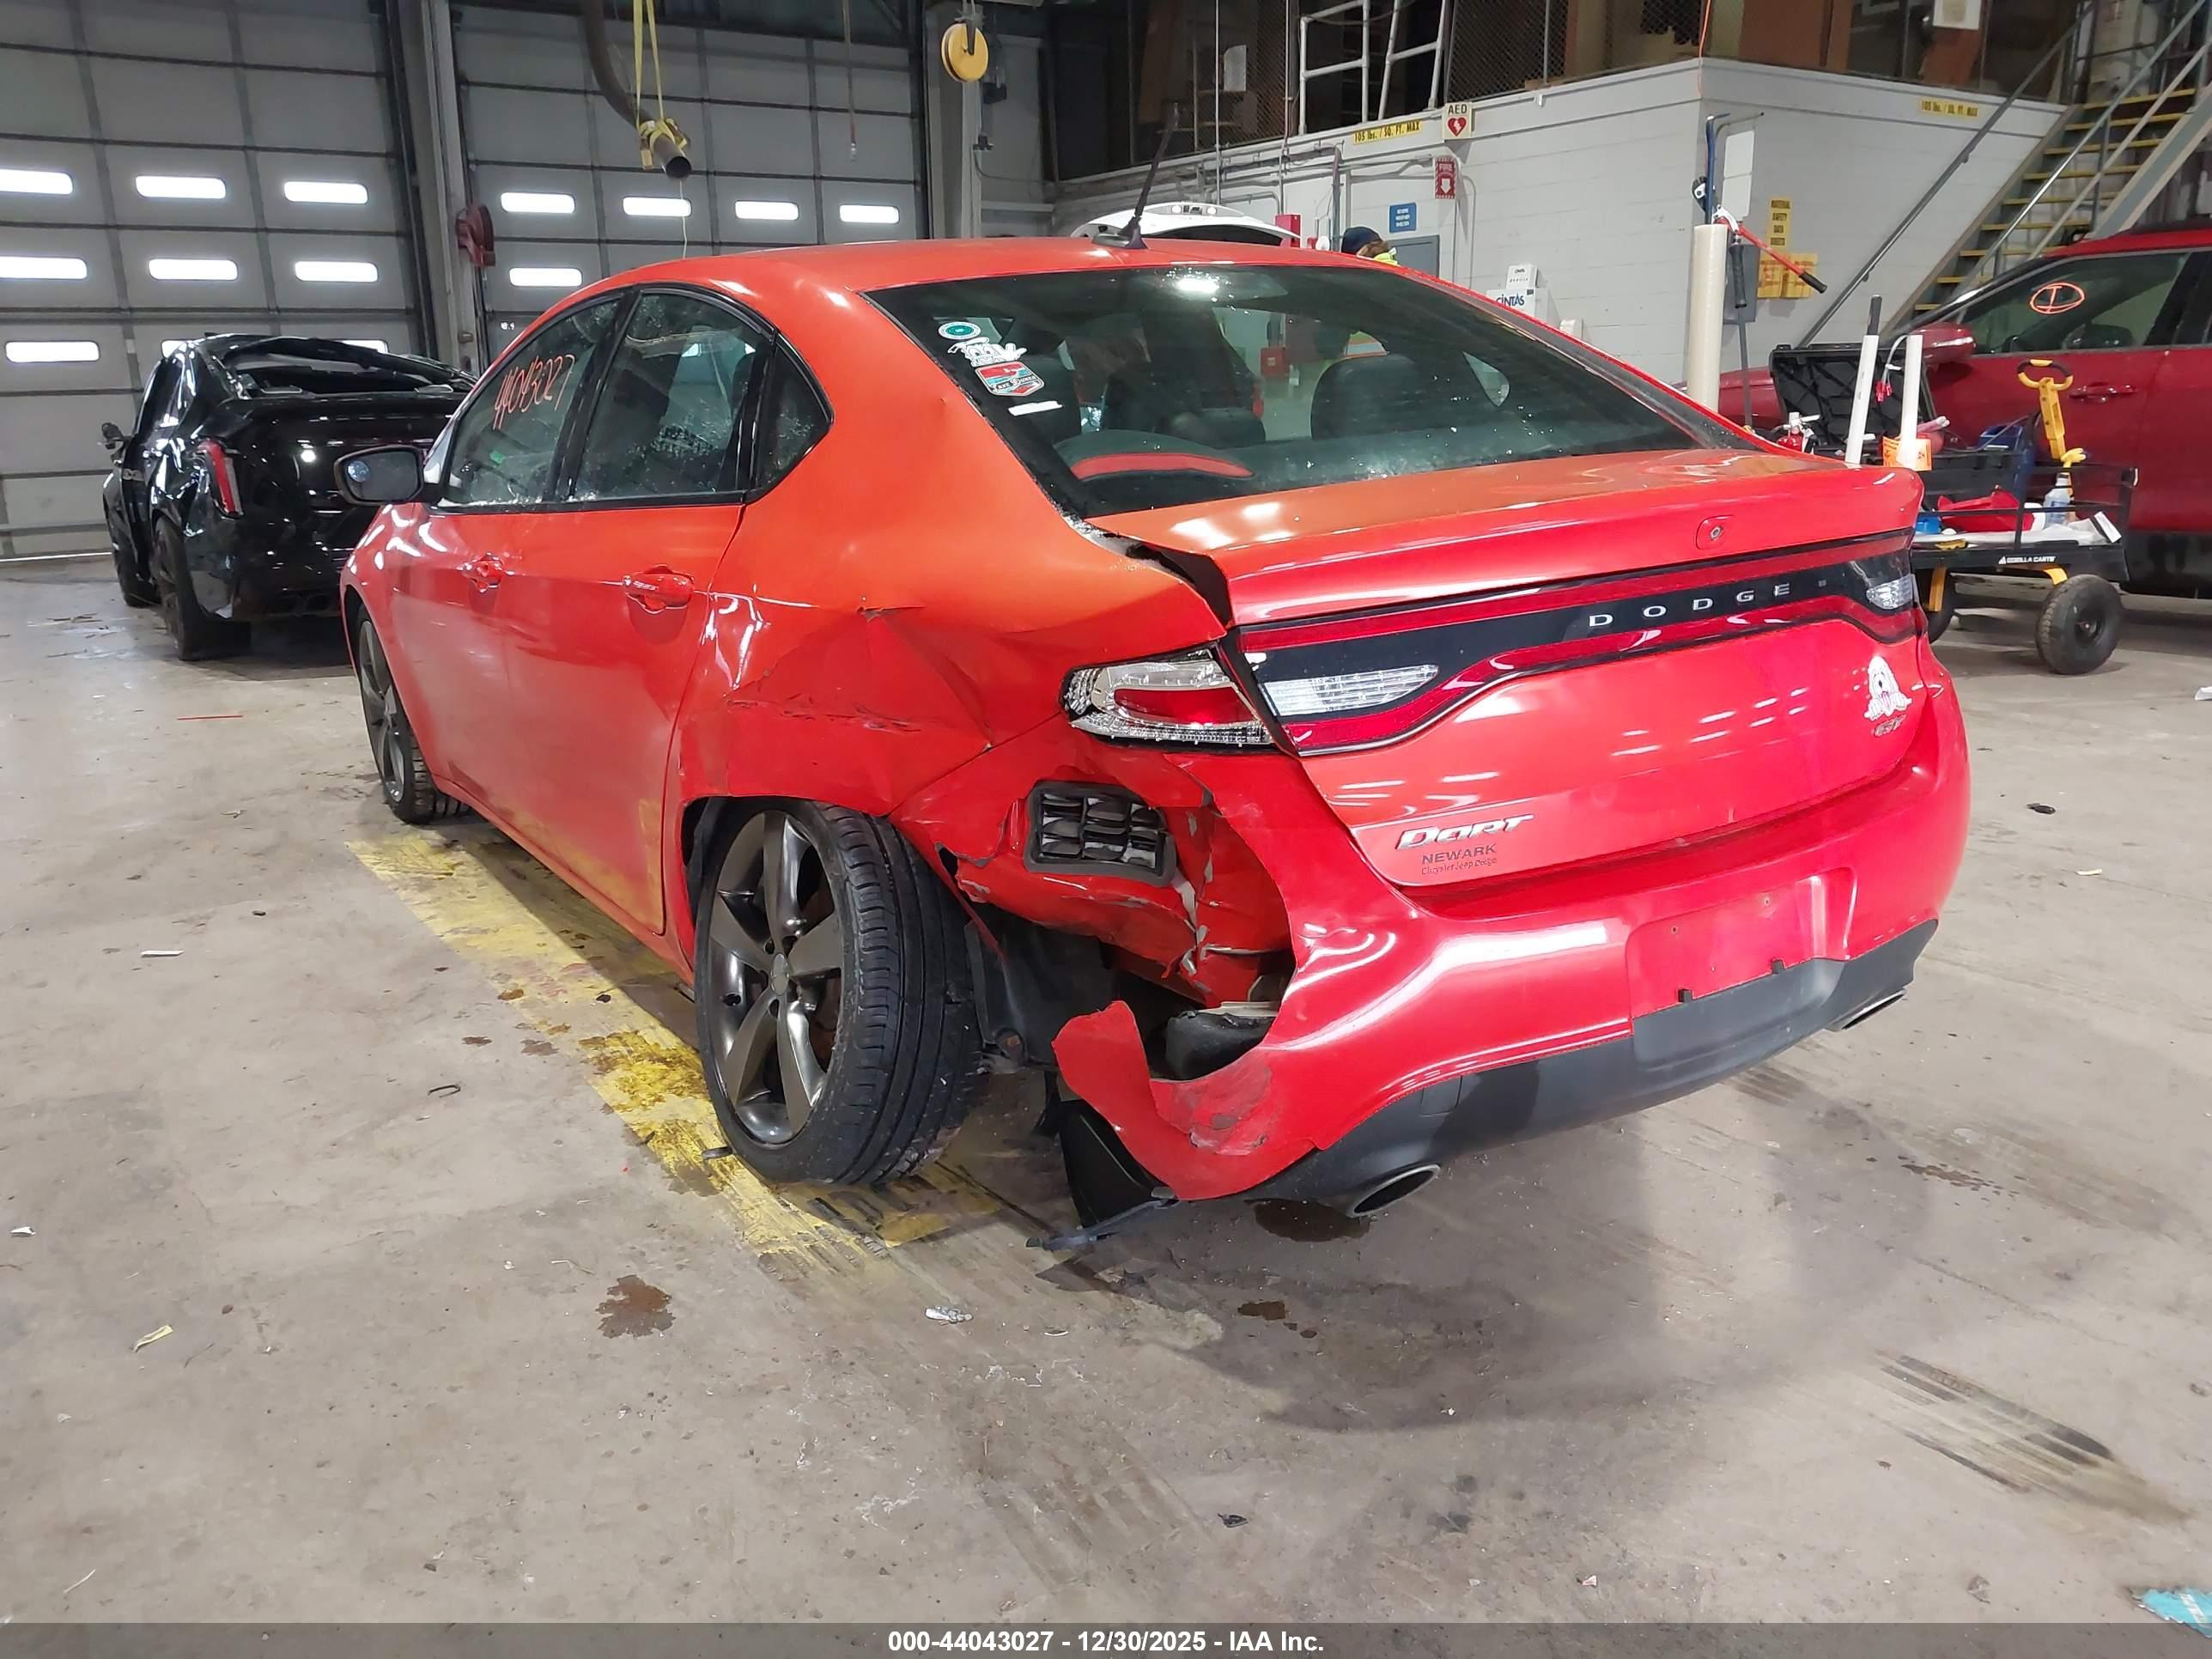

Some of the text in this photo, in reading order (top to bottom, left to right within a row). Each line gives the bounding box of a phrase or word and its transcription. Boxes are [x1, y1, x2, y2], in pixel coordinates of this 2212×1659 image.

[1448, 104, 1468, 115] AED
[1354, 133, 1365, 143] 105
[1384, 126, 1394, 137] SQ.
[1395, 125, 1404, 136] FT.
[1407, 121, 1420, 133] MAX
[1589, 582, 1791, 627] DODGE
[1421, 843, 1498, 865] NEWARK
